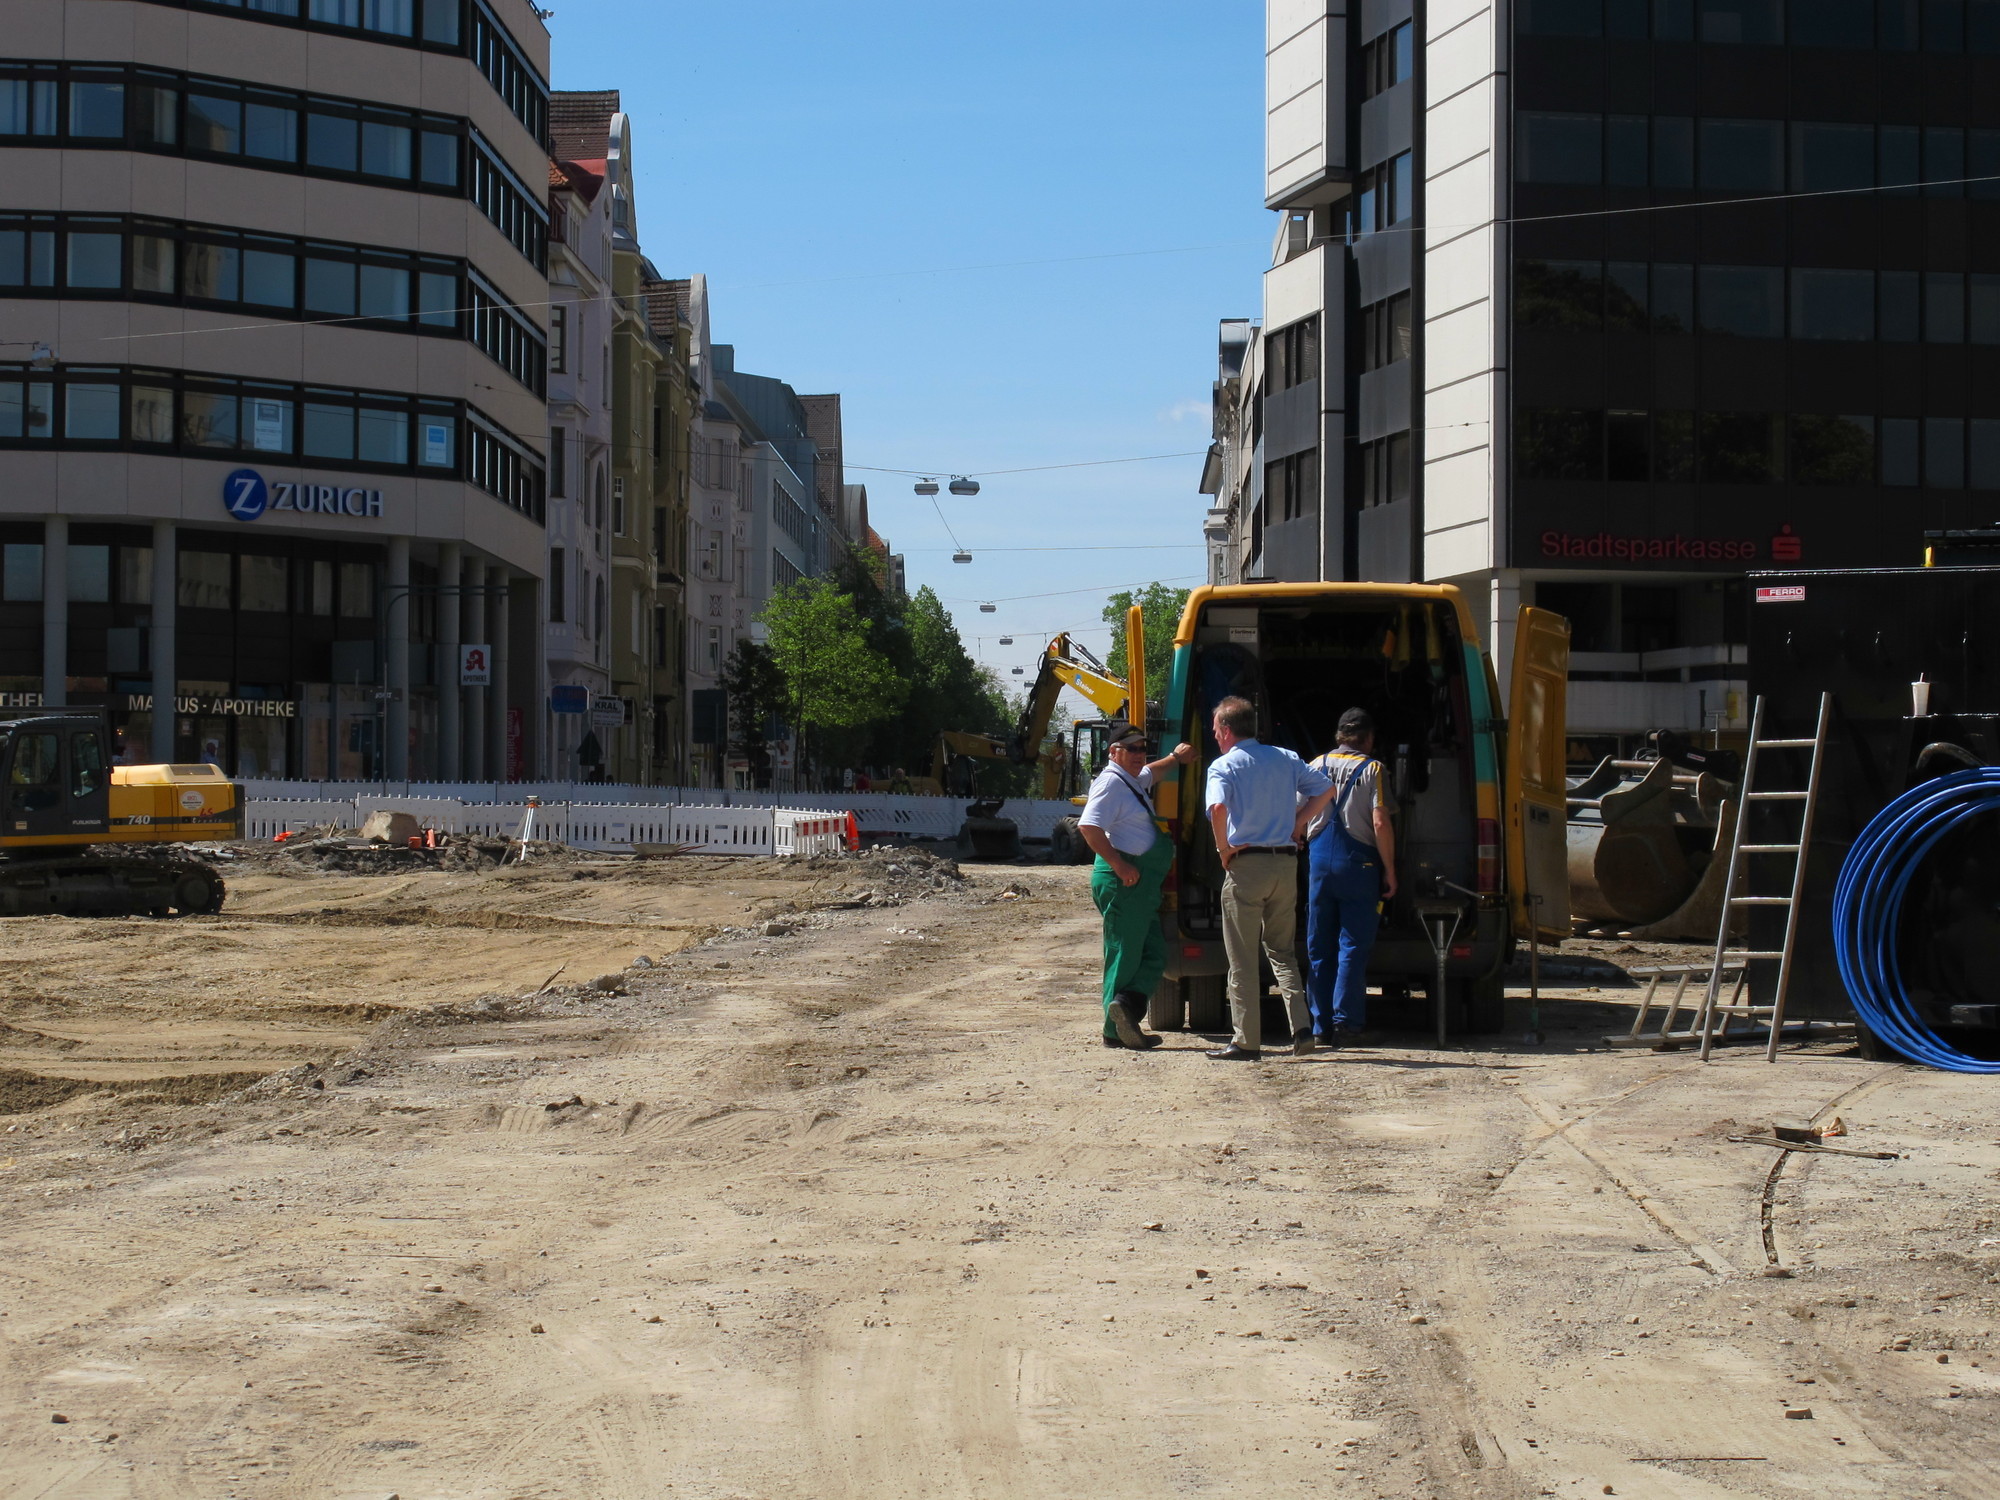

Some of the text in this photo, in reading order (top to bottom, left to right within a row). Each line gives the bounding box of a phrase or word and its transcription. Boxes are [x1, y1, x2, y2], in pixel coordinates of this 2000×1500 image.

[231, 478, 384, 518] Z ZURICH
[1541, 530, 1757, 562] Stadtsparkasse
[1769, 588, 1803, 596] FERRO
[463, 674, 487, 683] APOTHEKE
[0, 692, 44, 707] THE
[128, 694, 199, 713] MAUS
[211, 698, 295, 717] APOTHEKE
[594, 701, 618, 711] KRAL
[128, 815, 150, 825] 740
